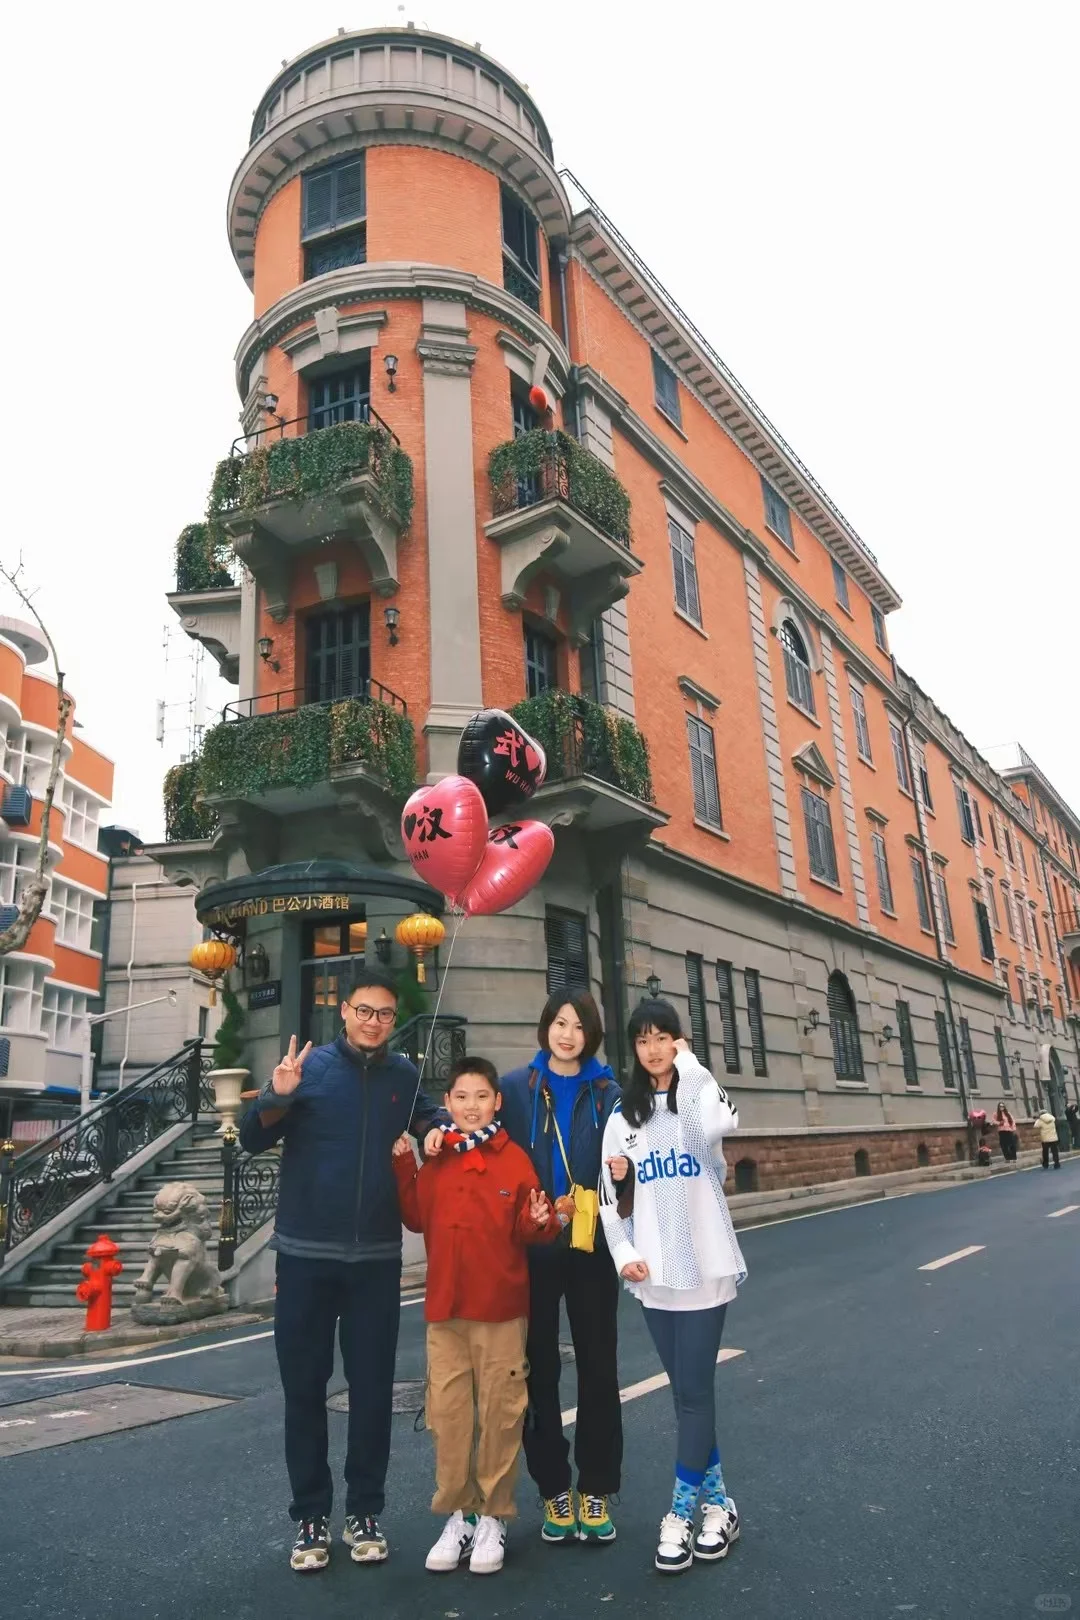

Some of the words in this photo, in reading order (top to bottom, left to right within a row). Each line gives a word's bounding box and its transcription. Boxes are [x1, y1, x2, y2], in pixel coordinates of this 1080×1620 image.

[493, 728, 524, 767] 武
[505, 769, 520, 784] WU
[417, 806, 452, 843] 汉
[273, 895, 349, 912] 巴公小酒馆
[638, 1148, 701, 1184] adidas
